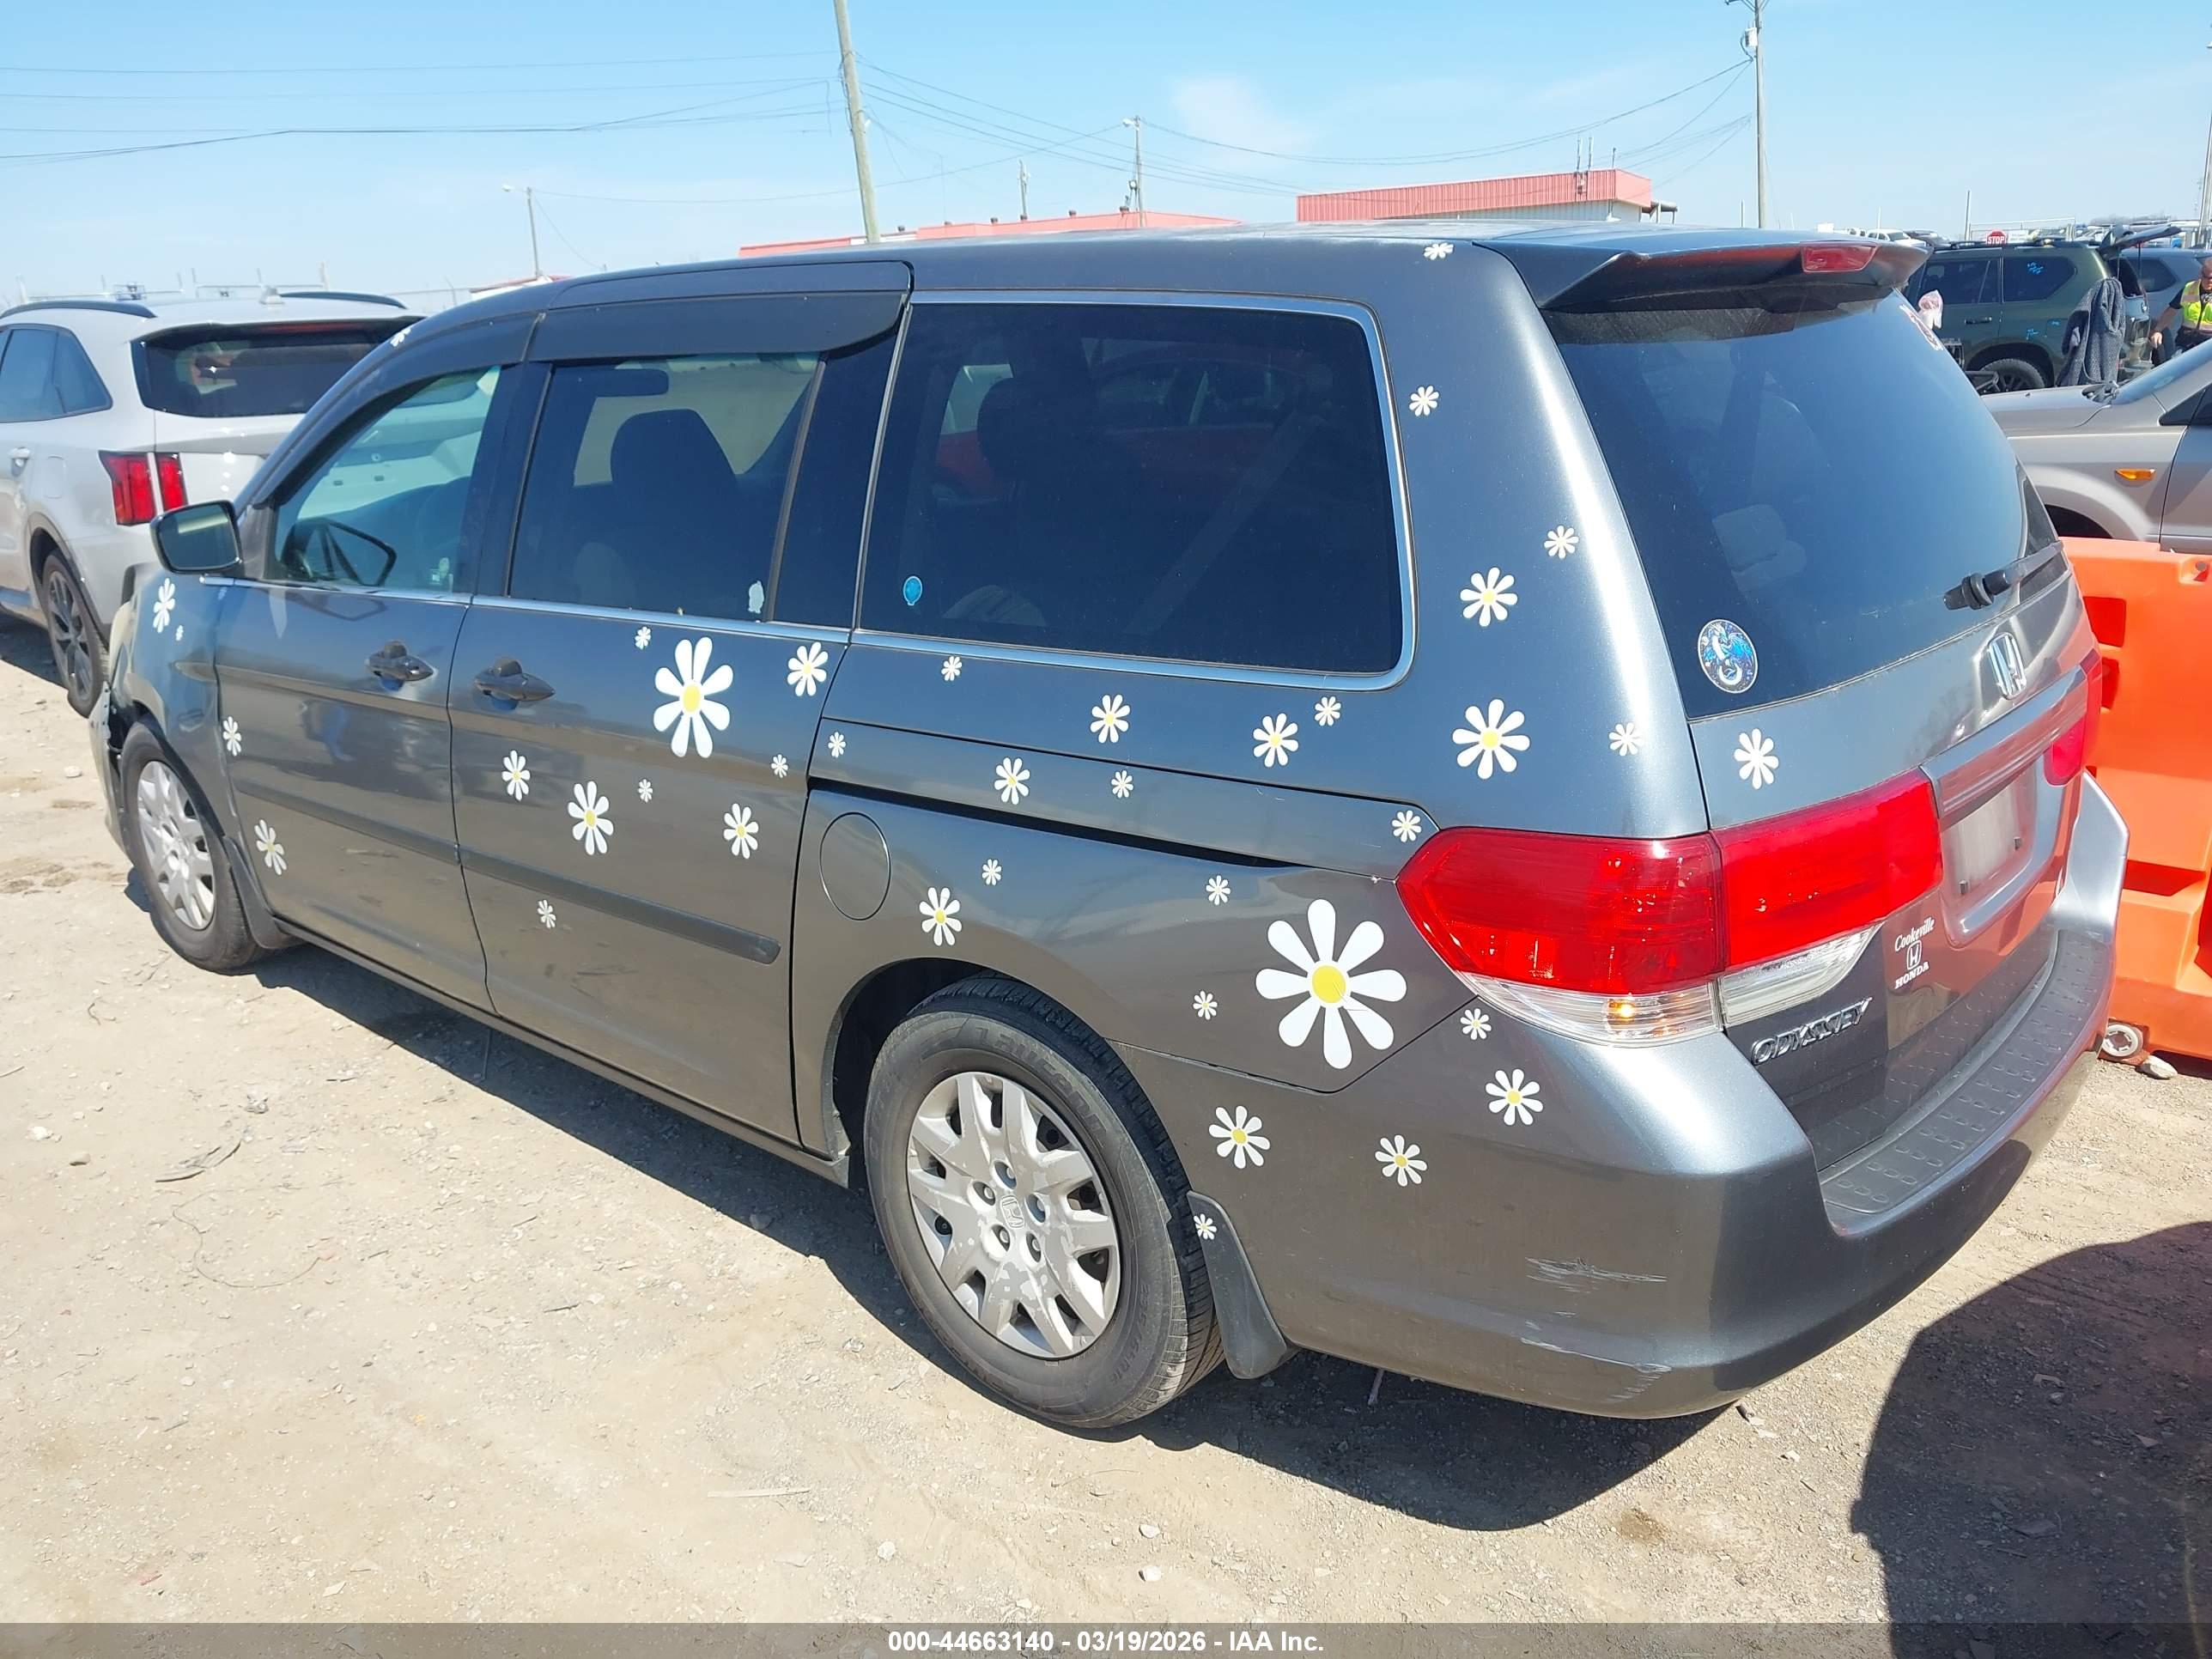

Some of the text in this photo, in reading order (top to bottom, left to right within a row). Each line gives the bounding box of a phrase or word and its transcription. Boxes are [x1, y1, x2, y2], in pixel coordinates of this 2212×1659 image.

[1988, 235, 2005, 244] STOP
[1894, 916, 1936, 952] Cookeville
[1894, 961, 1929, 990] HONDA
[1751, 996, 1873, 1066] ODYSSEY
